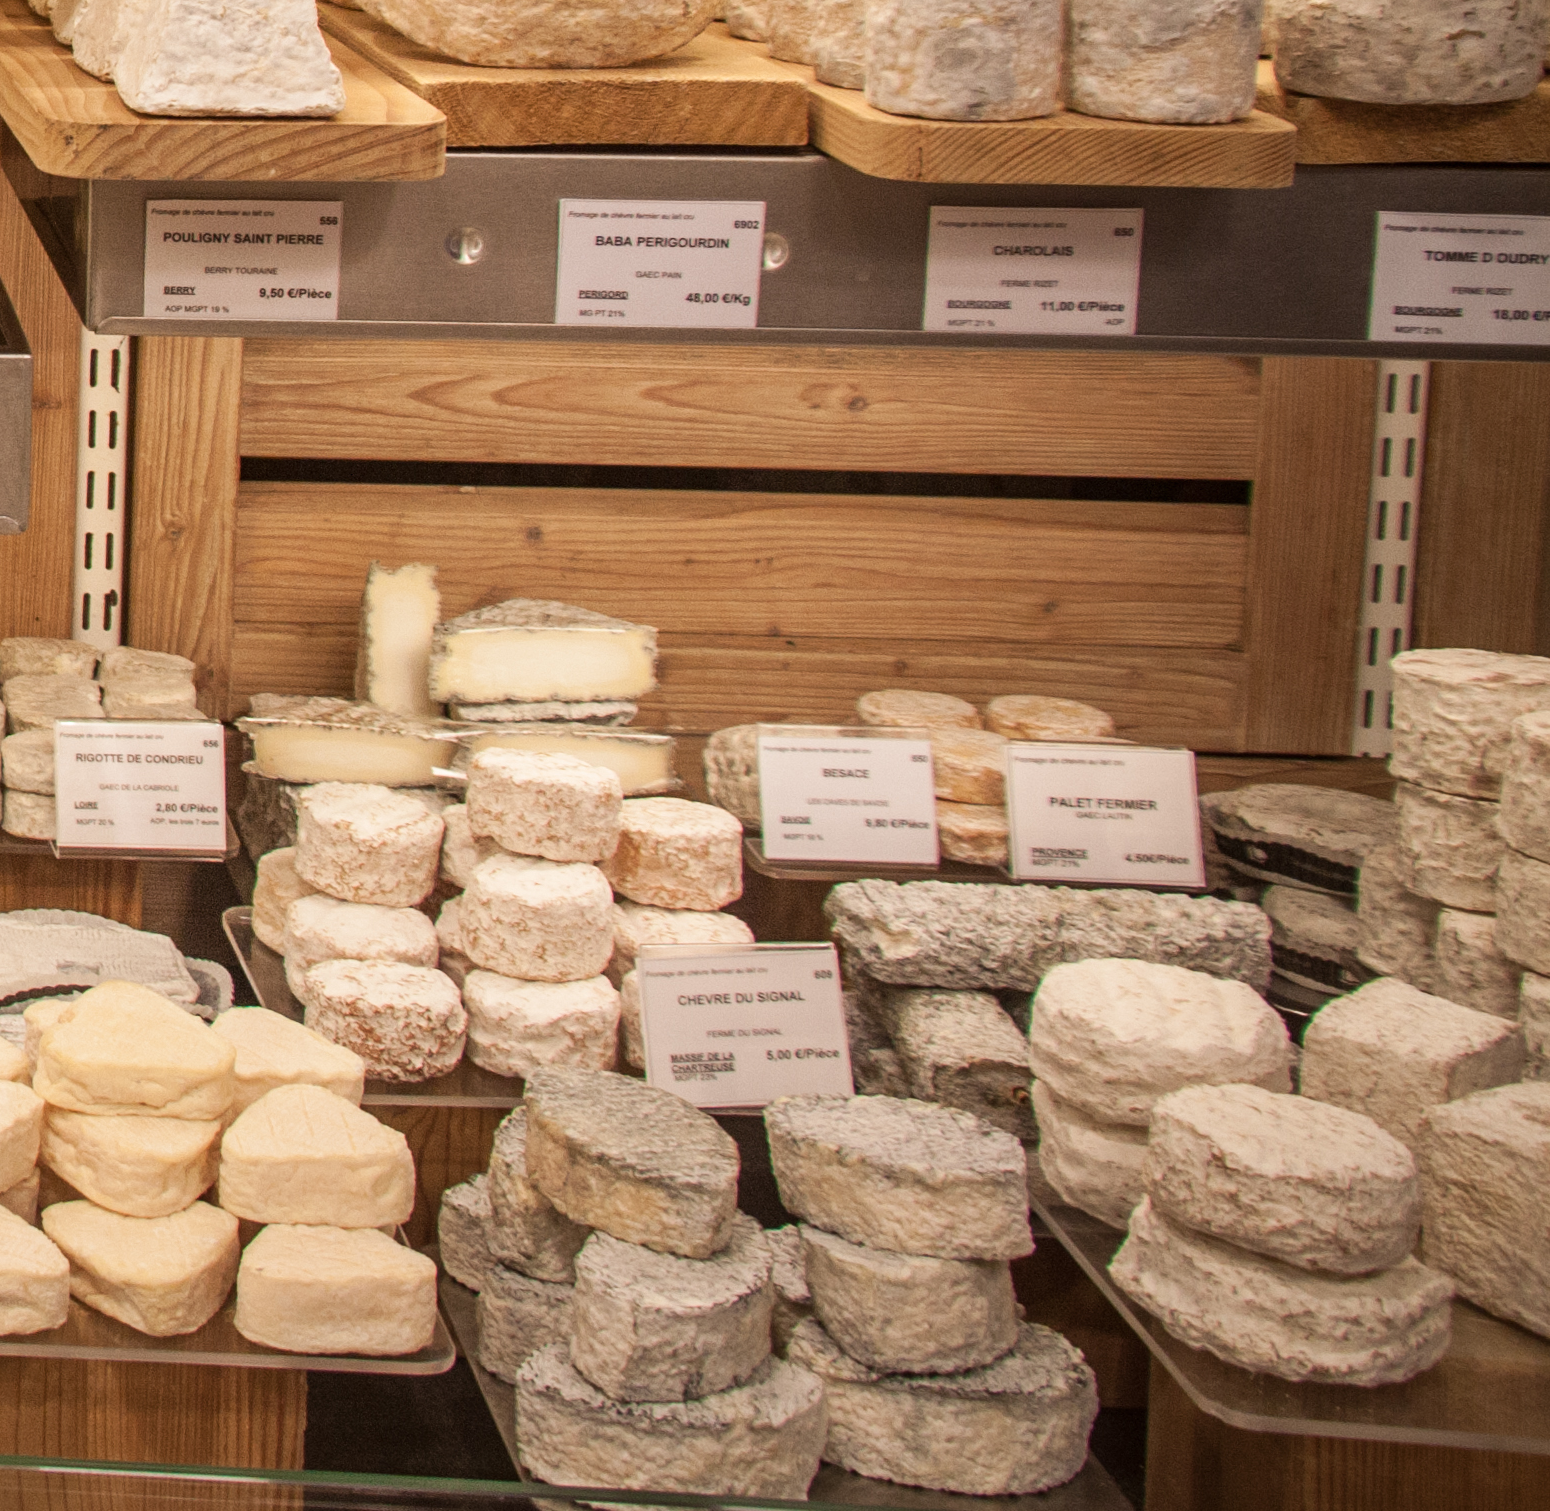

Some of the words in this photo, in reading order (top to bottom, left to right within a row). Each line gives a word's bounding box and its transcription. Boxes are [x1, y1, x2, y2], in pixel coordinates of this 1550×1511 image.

[164, 233, 230, 243] POULIGNY
[234, 234, 272, 243] SAINT
[276, 234, 323, 244] PIERRE
[595, 236, 632, 246] BABA
[637, 237, 729, 248] PERIGOURDIN
[993, 246, 1074, 256] CHAROLAIS
[1424, 250, 1478, 262] TOMME
[1482, 253, 1493, 262] D
[1497, 253, 1549, 264] OUDRY
[260, 289, 284, 299] 9,50
[288, 288, 332, 299] €/Pièce
[76, 753, 123, 763] RIGOTTE
[127, 755, 141, 763] DE
[146, 755, 203, 764] CONDRIEU
[822, 769, 869, 778] BESACE
[156, 804, 177, 813] 2,80
[180, 804, 218, 813] €/Pièce
[1048, 797, 1092, 808] PALET
[1097, 798, 1157, 810] FERMIER
[678, 993, 731, 1005] CHEVRE
[736, 993, 753, 1003] DU
[757, 991, 805, 1002] SIGNAL
[766, 1049, 791, 1061] 5,00
[795, 1048, 839, 1059] €/Pièce
